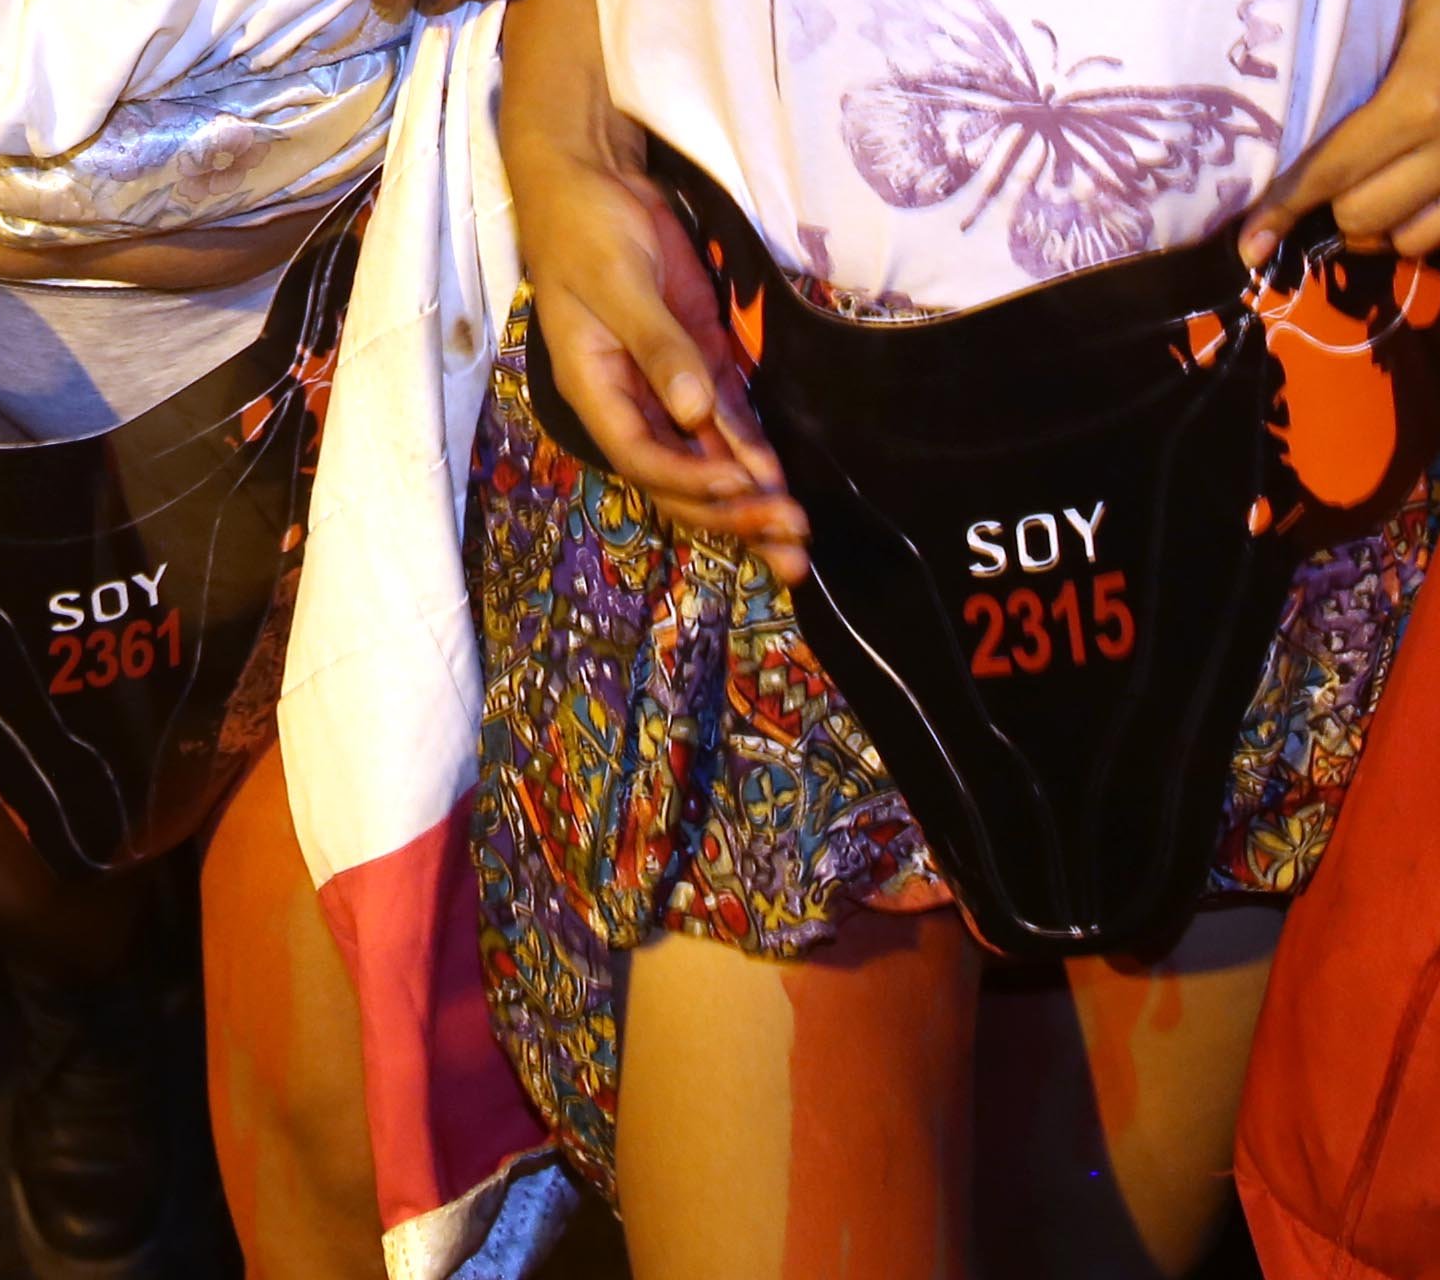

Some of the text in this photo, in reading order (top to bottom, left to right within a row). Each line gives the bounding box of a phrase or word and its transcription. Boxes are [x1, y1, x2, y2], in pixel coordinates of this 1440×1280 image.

[966, 501, 1106, 578] SOY
[49, 563, 169, 632] SOY
[962, 570, 1137, 679] 2315
[49, 609, 184, 696] 2361
